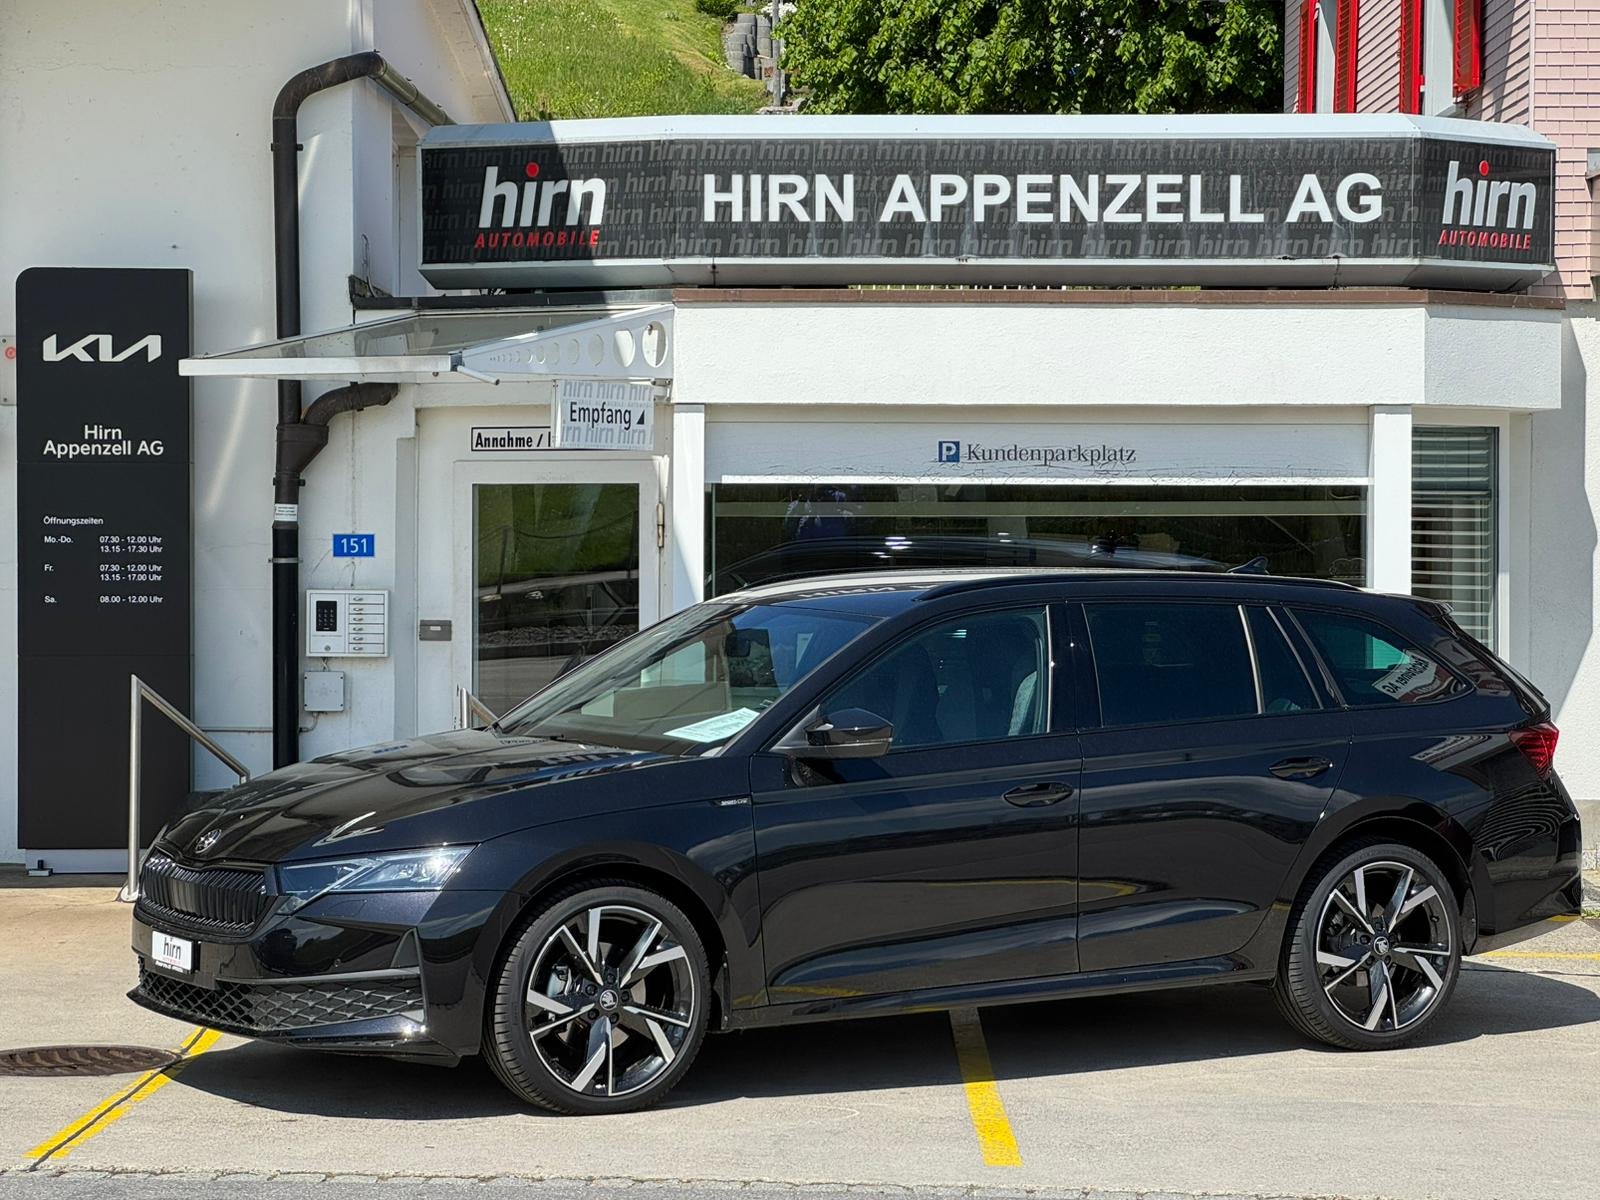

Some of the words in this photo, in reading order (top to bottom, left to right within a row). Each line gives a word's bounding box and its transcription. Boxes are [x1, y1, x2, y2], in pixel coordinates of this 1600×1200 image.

[479, 162, 606, 228] hirn
[704, 174, 854, 223] HIRN
[880, 174, 1265, 223] APPENZELL
[1284, 172, 1383, 223] AG
[1442, 160, 1537, 229] hirn
[474, 229, 600, 249] AUTOMOBILE
[1439, 230, 1532, 250] AUTOMOBILE
[43, 334, 161, 362] KIA
[570, 401, 632, 431] Empfang
[84, 424, 122, 440] Hirn
[475, 431, 533, 448] Annahme
[43, 440, 131, 459] Appenzell
[137, 440, 164, 456] AG
[967, 443, 1137, 466] Kundenparkplatz
[43, 515, 104, 527] Öffnungszeiten
[44, 535, 74, 544] Mo.-Do.
[100, 545, 120, 553] 13.15
[127, 545, 148, 553] 17.30
[149, 545, 163, 553] Uhr
[341, 538, 368, 553] 151
[44, 564, 54, 572] Fr.
[44, 595, 57, 603] Sa.
